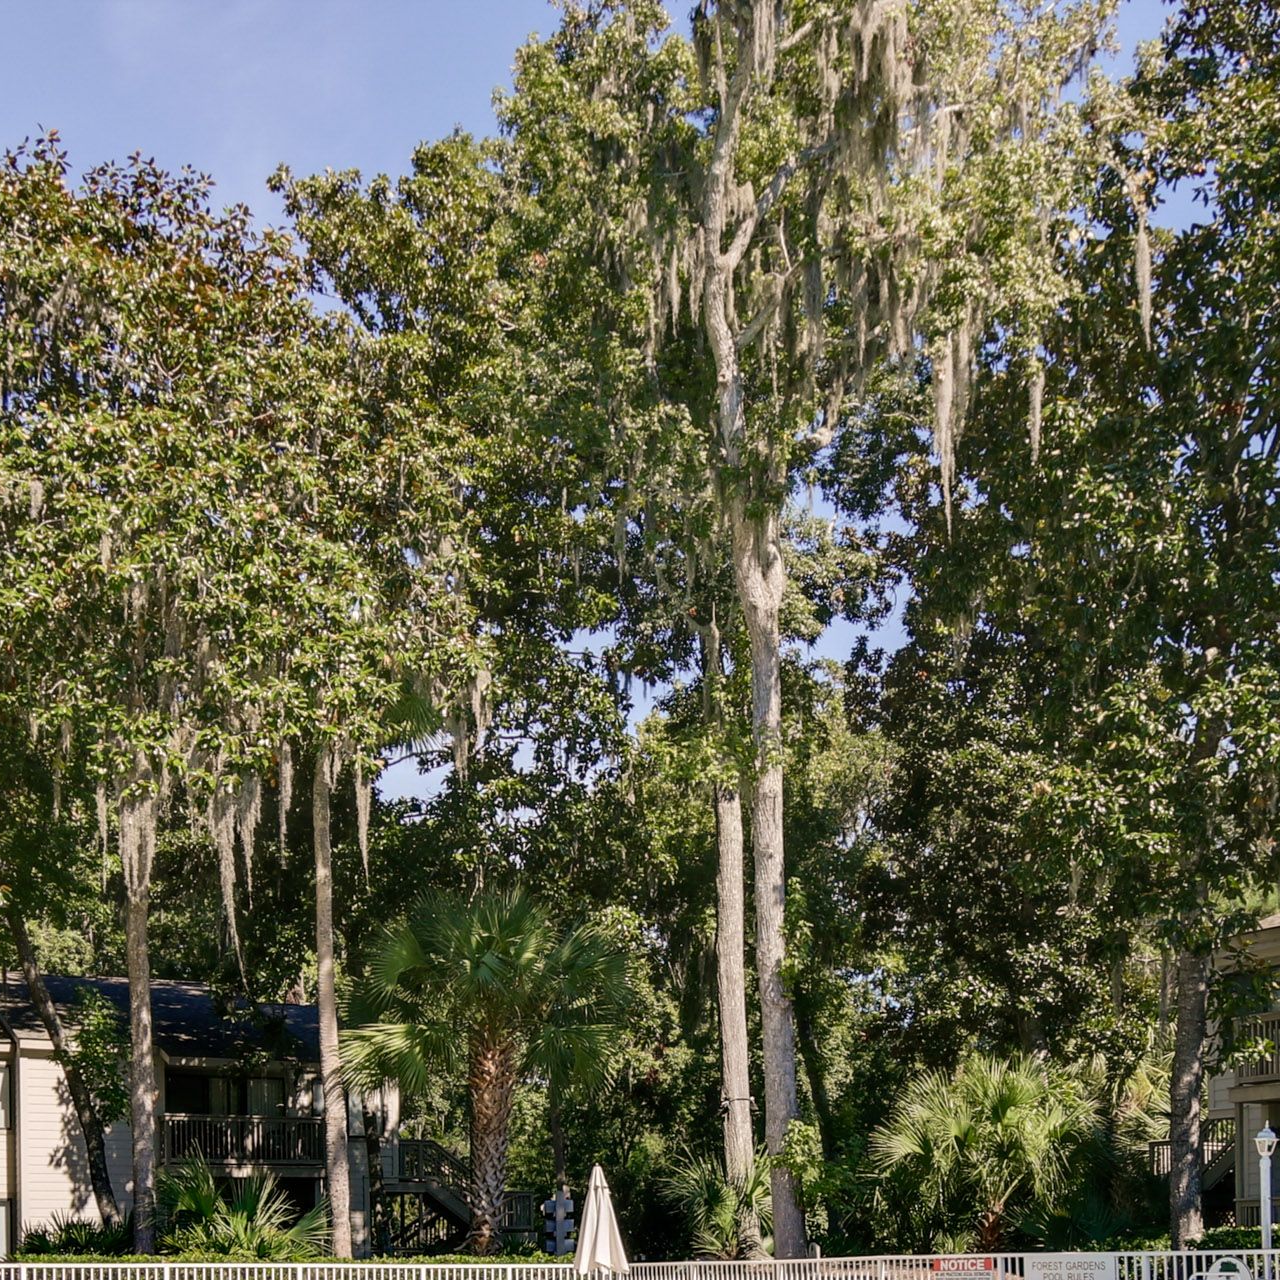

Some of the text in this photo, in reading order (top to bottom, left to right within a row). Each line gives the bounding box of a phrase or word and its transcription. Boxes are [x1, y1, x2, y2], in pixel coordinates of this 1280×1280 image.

[940, 1259, 985, 1271] NOTICE
[1032, 1261, 1106, 1271] FOREST GARDENS
